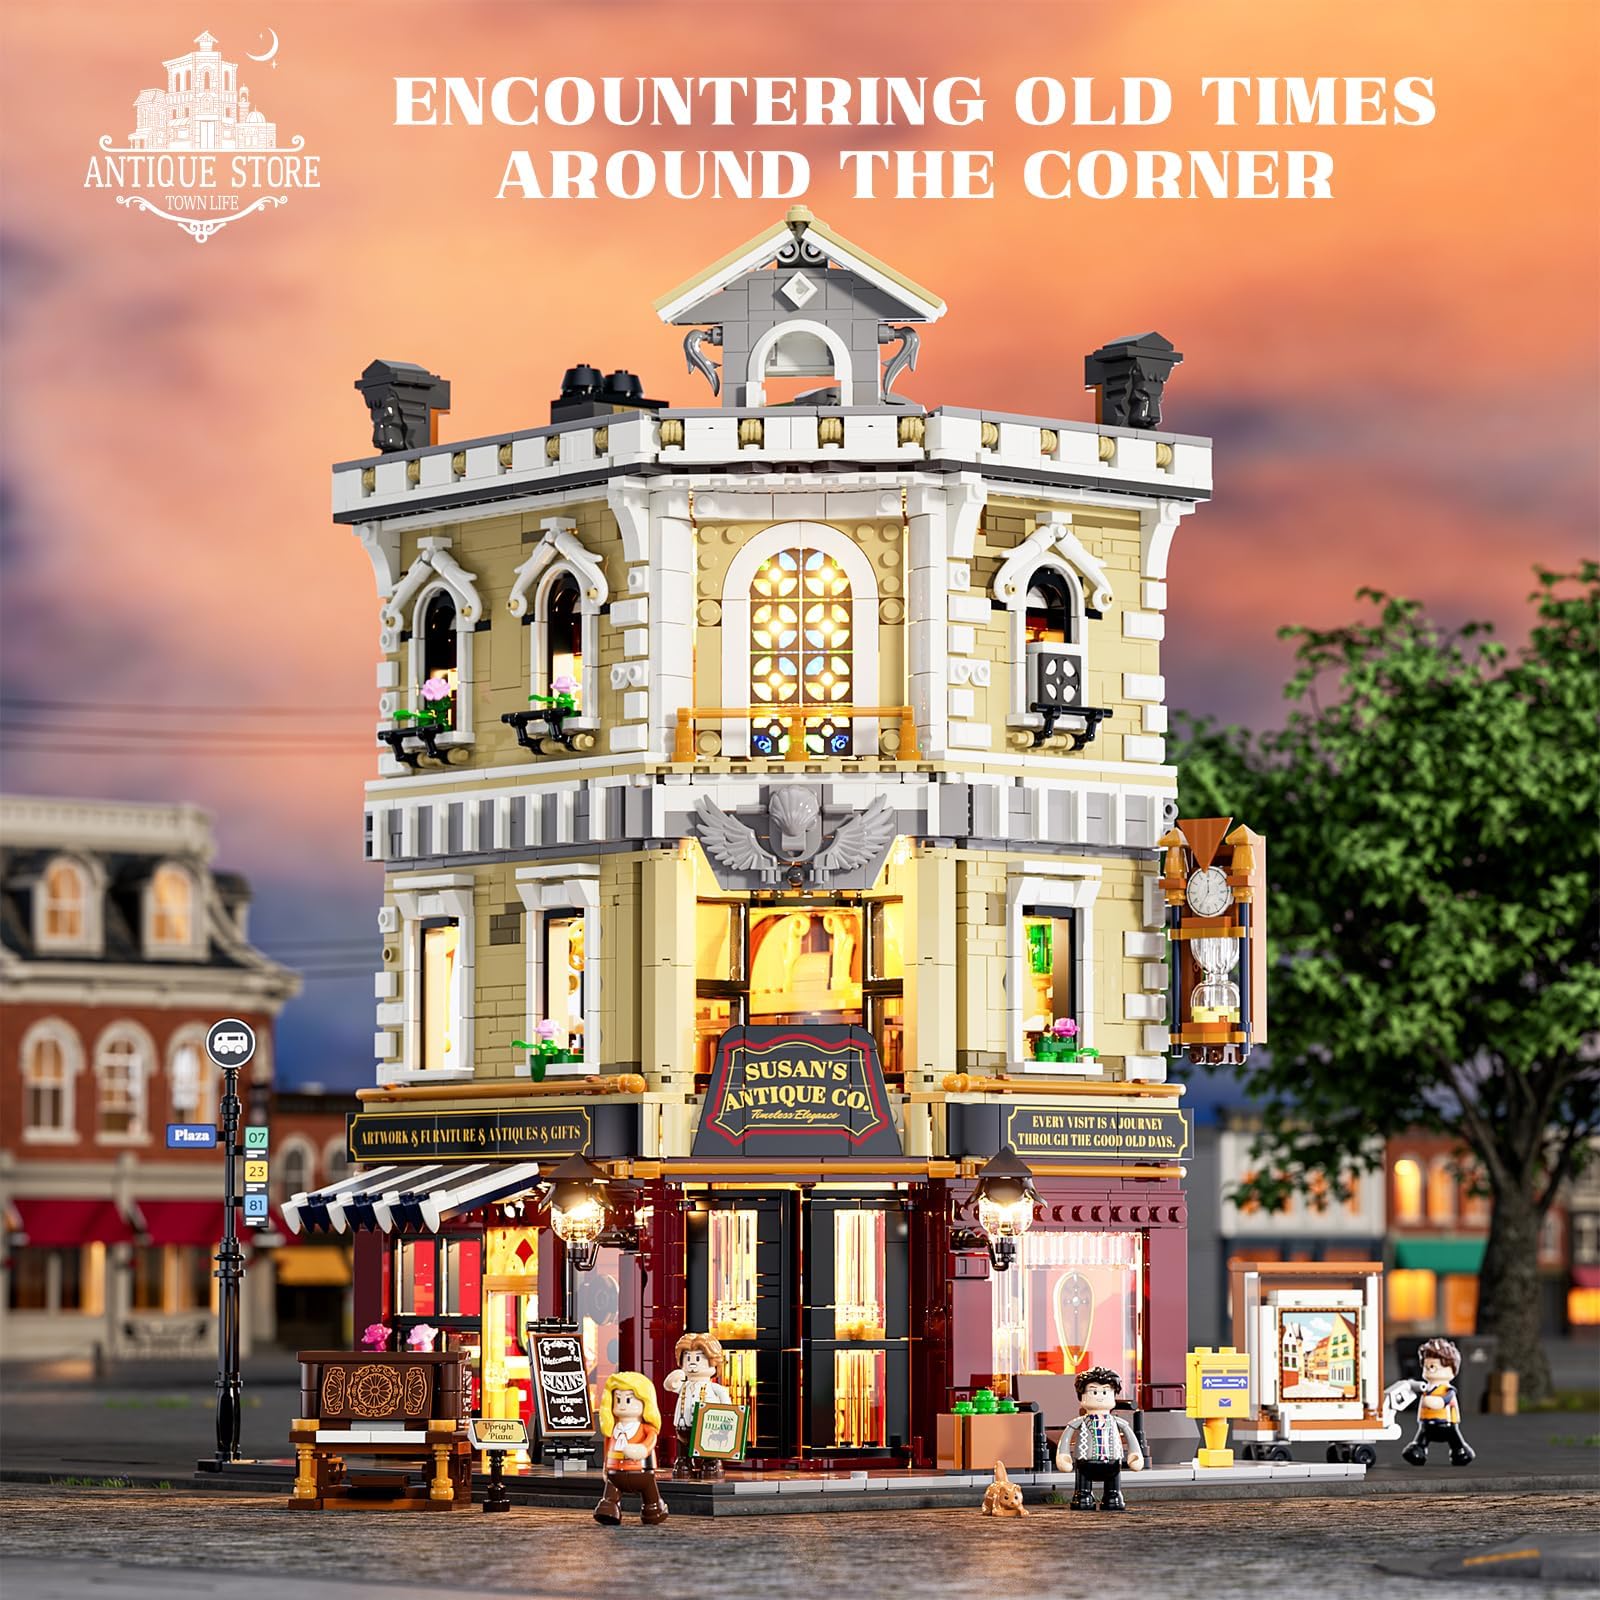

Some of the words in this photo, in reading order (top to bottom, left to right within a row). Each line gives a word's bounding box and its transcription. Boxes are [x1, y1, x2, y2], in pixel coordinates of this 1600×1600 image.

[745, 1060, 848, 1081] SUSAN'S
[725, 1085, 826, 1112] ANTIQUE
[832, 1090, 870, 1112] CO.
[751, 1109, 794, 1120] Timeless
[794, 1109, 841, 1124] Elegance
[1032, 1115, 1064, 1129] EVERY
[1068, 1116, 1095, 1129] VISIT
[1097, 1117, 1108, 1129] IS
[1110, 1117, 1117, 1129] A
[1118, 1117, 1164, 1131] JOURNEY
[174, 1129, 210, 1142] Plaza
[248, 1132, 266, 1144] 07
[361, 1130, 409, 1146] ARTWORK
[420, 1128, 477, 1144] FURNITURE
[488, 1125, 539, 1144] ANTIQUES
[550, 1124, 581, 1140] GIFTS
[1017, 1132, 1068, 1146] THROUGH
[1071, 1133, 1092, 1147] THE
[1093, 1134, 1123, 1147] GOOD
[1125, 1134, 1146, 1148] OLD
[1148, 1135, 1176, 1149] DAYS.
[249, 1166, 265, 1178] 23
[249, 1200, 263, 1211] 81
[541, 1355, 573, 1365] Welcome
[551, 1396, 583, 1406] Antique
[560, 1404, 574, 1413] Co.
[482, 1422, 515, 1433] Upright
